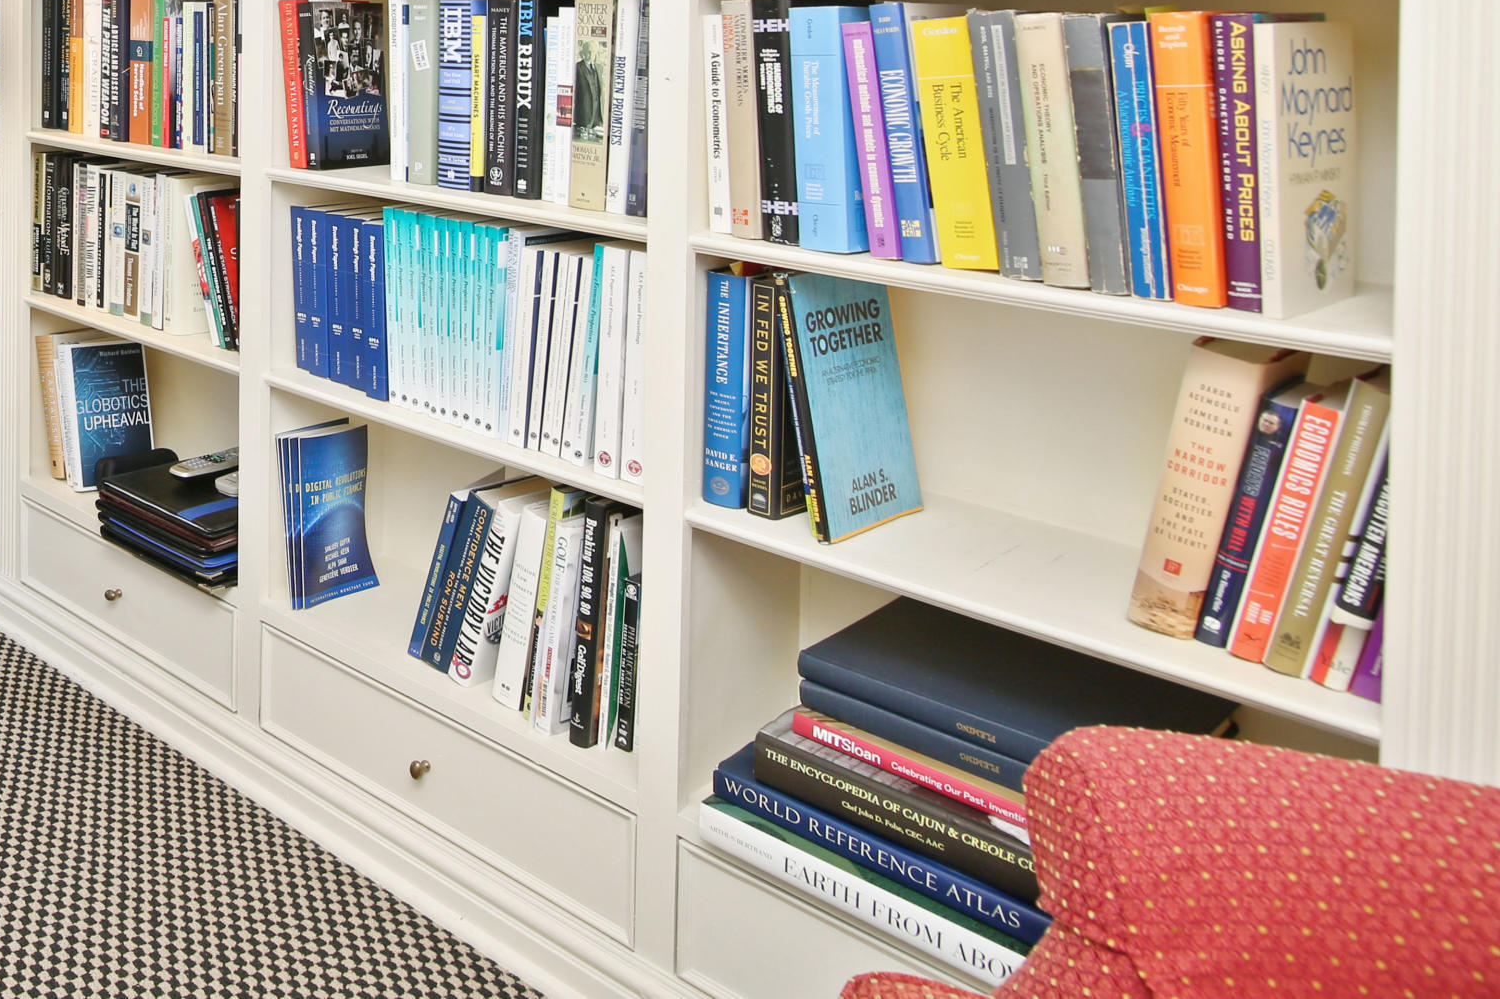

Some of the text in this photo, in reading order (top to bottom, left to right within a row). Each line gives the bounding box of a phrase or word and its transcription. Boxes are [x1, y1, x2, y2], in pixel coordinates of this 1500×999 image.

[100, 8, 111, 125] THE PERFECT WEAPON
[110, 24, 119, 106] ADVICE AND DISSENT
[214, 1, 228, 106] Alan Greenspan
[443, 7, 462, 63] IBM
[515, 1, 534, 110] IBM REDUX
[495, 16, 508, 164] THE MAVERICK AND HIS MACHINE
[610, 55, 627, 146] BROKEN PROMISES
[710, 51, 723, 159] A Guide to Econometrics
[879, 68, 917, 184] ECONOMIC GROWTH
[931, 84, 951, 161] Business Cycle
[948, 83, 968, 159] The American
[1228, 21, 1256, 242] ASKING ABOUT PRICES
[715, 280, 730, 385] THE INHERITANCE
[805, 298, 881, 334] GROWING
[809, 322, 884, 358] TOGETHER
[76, 394, 148, 415] GLOBOTICS
[121, 379, 146, 393] THE
[754, 294, 769, 449] IN FED WE TRUST
[83, 411, 151, 430] UPHEAVAL
[848, 483, 898, 516] BLINDER
[851, 467, 889, 494] ALAN S.
[1271, 415, 1331, 540] ECONOMICS RULES
[454, 508, 488, 610] CONFIDENCE MEN
[456, 530, 506, 666] THE VICTORY LAB
[579, 517, 598, 616] Breaking 100, 90, 80
[429, 571, 456, 647] RON SUSKIND
[812, 724, 882, 766] MITSloan
[724, 776, 1021, 928] WORLD REFERENCE ATLAS
[764, 748, 1016, 865] THE ENCYCLOPEDIA OF CAJUN & CREOLE
[783, 855, 942, 950] EARTH FROM
